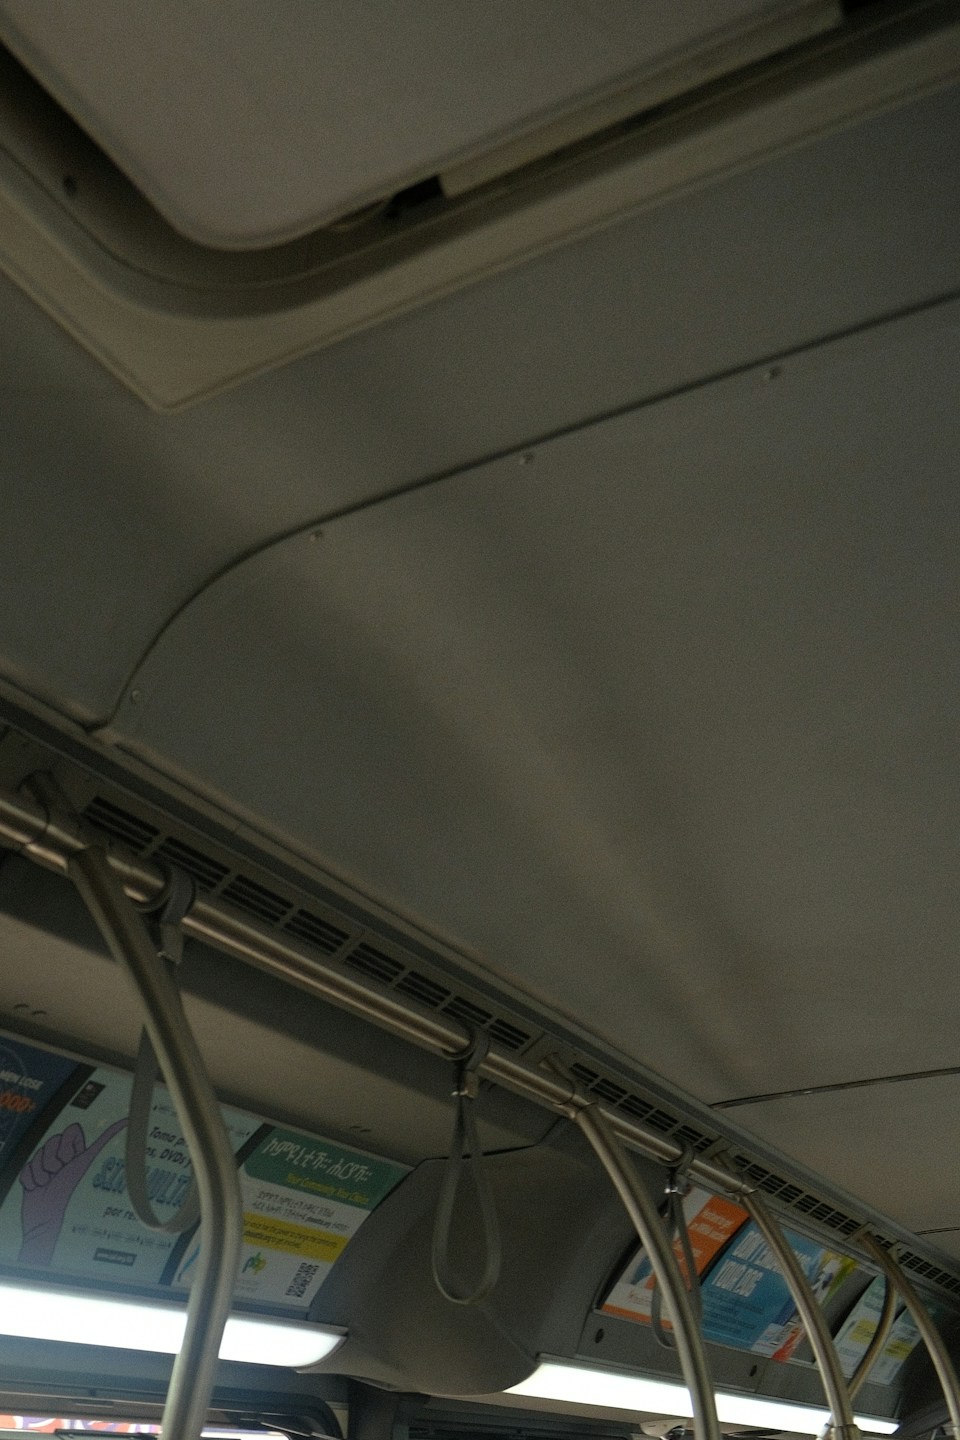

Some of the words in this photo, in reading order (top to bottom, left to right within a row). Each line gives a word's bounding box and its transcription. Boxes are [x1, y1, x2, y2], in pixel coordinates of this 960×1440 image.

[149, 1126, 176, 1143] Toma
[159, 1148, 185, 1165] DVDs
[102, 1205, 123, 1219] por
